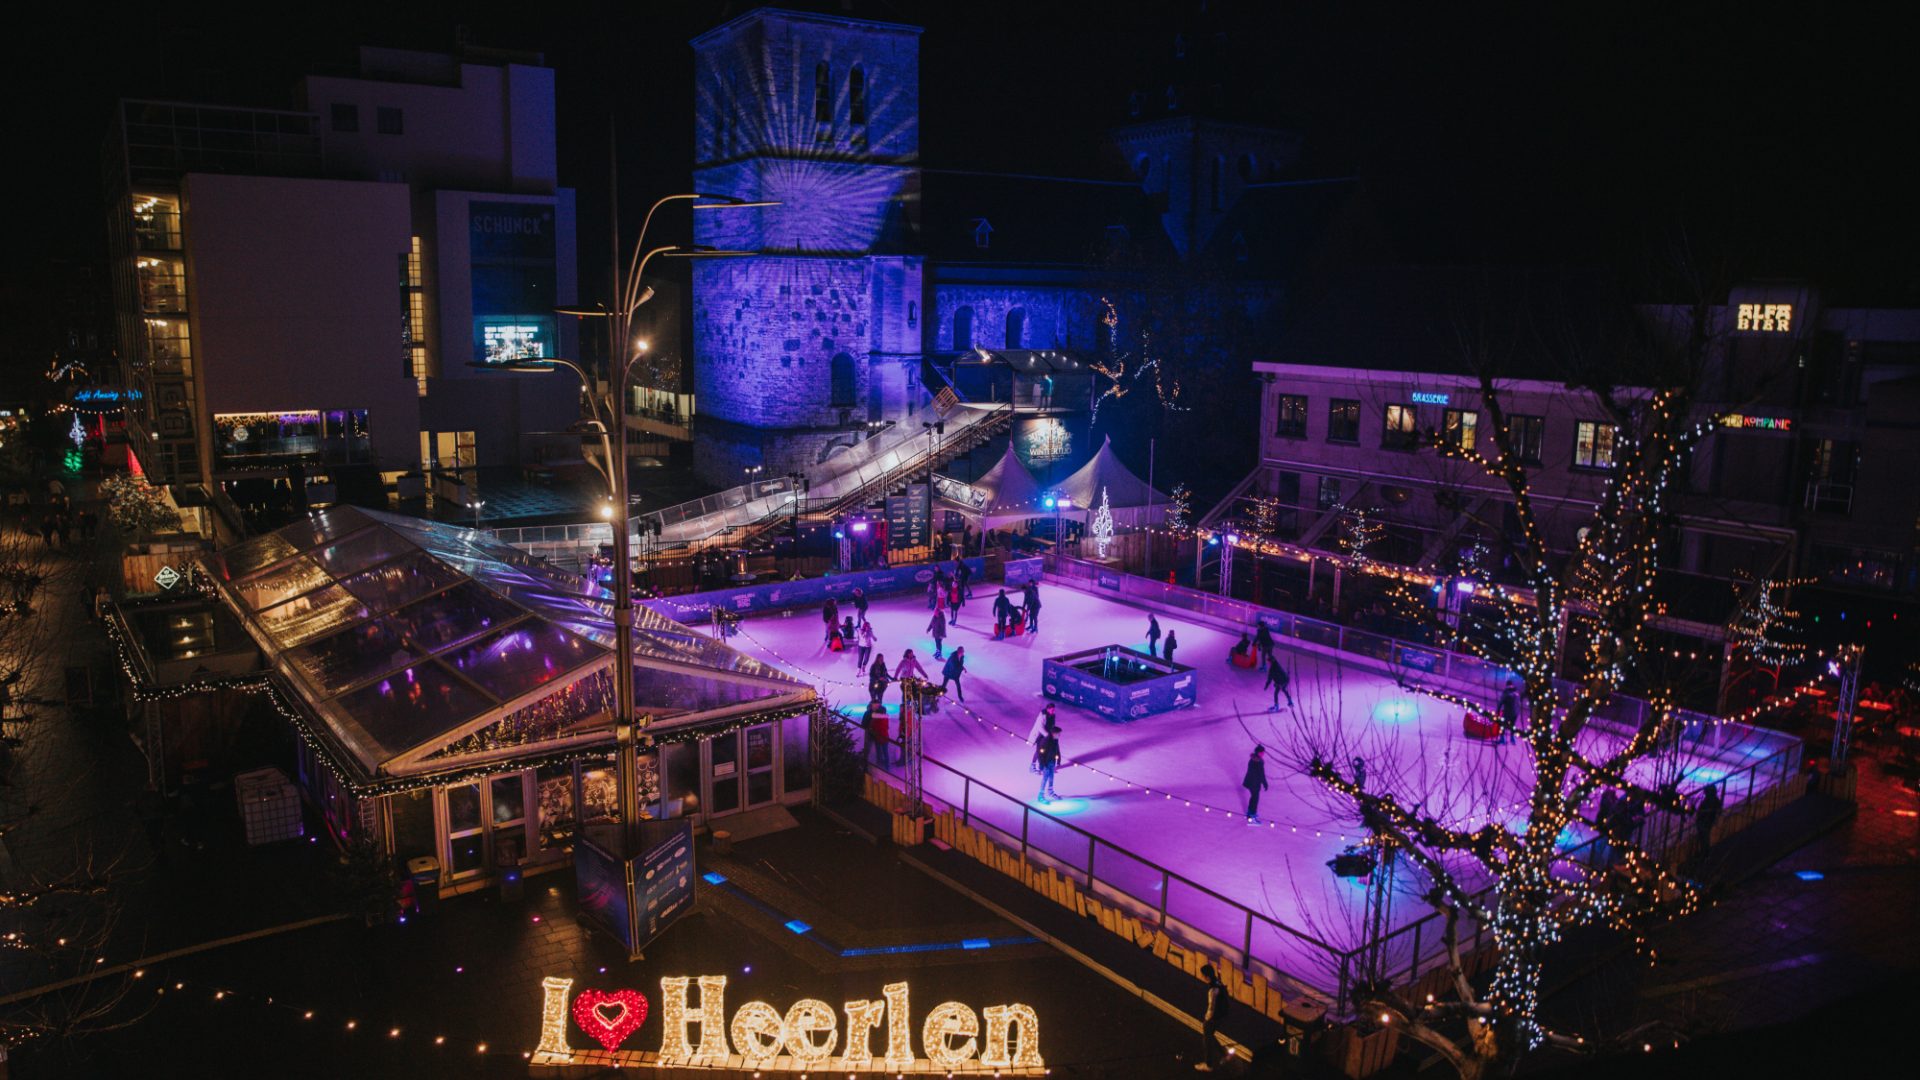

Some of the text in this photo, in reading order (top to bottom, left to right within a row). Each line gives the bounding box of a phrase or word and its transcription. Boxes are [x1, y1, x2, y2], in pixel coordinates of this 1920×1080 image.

[473, 215, 542, 235] SCHUNCK
[1737, 303, 1792, 320] ALFA
[1737, 319, 1790, 332] BIER
[1412, 392, 1449, 405] BRASSERIE
[537, 974, 1044, 1067] I Heerlen
